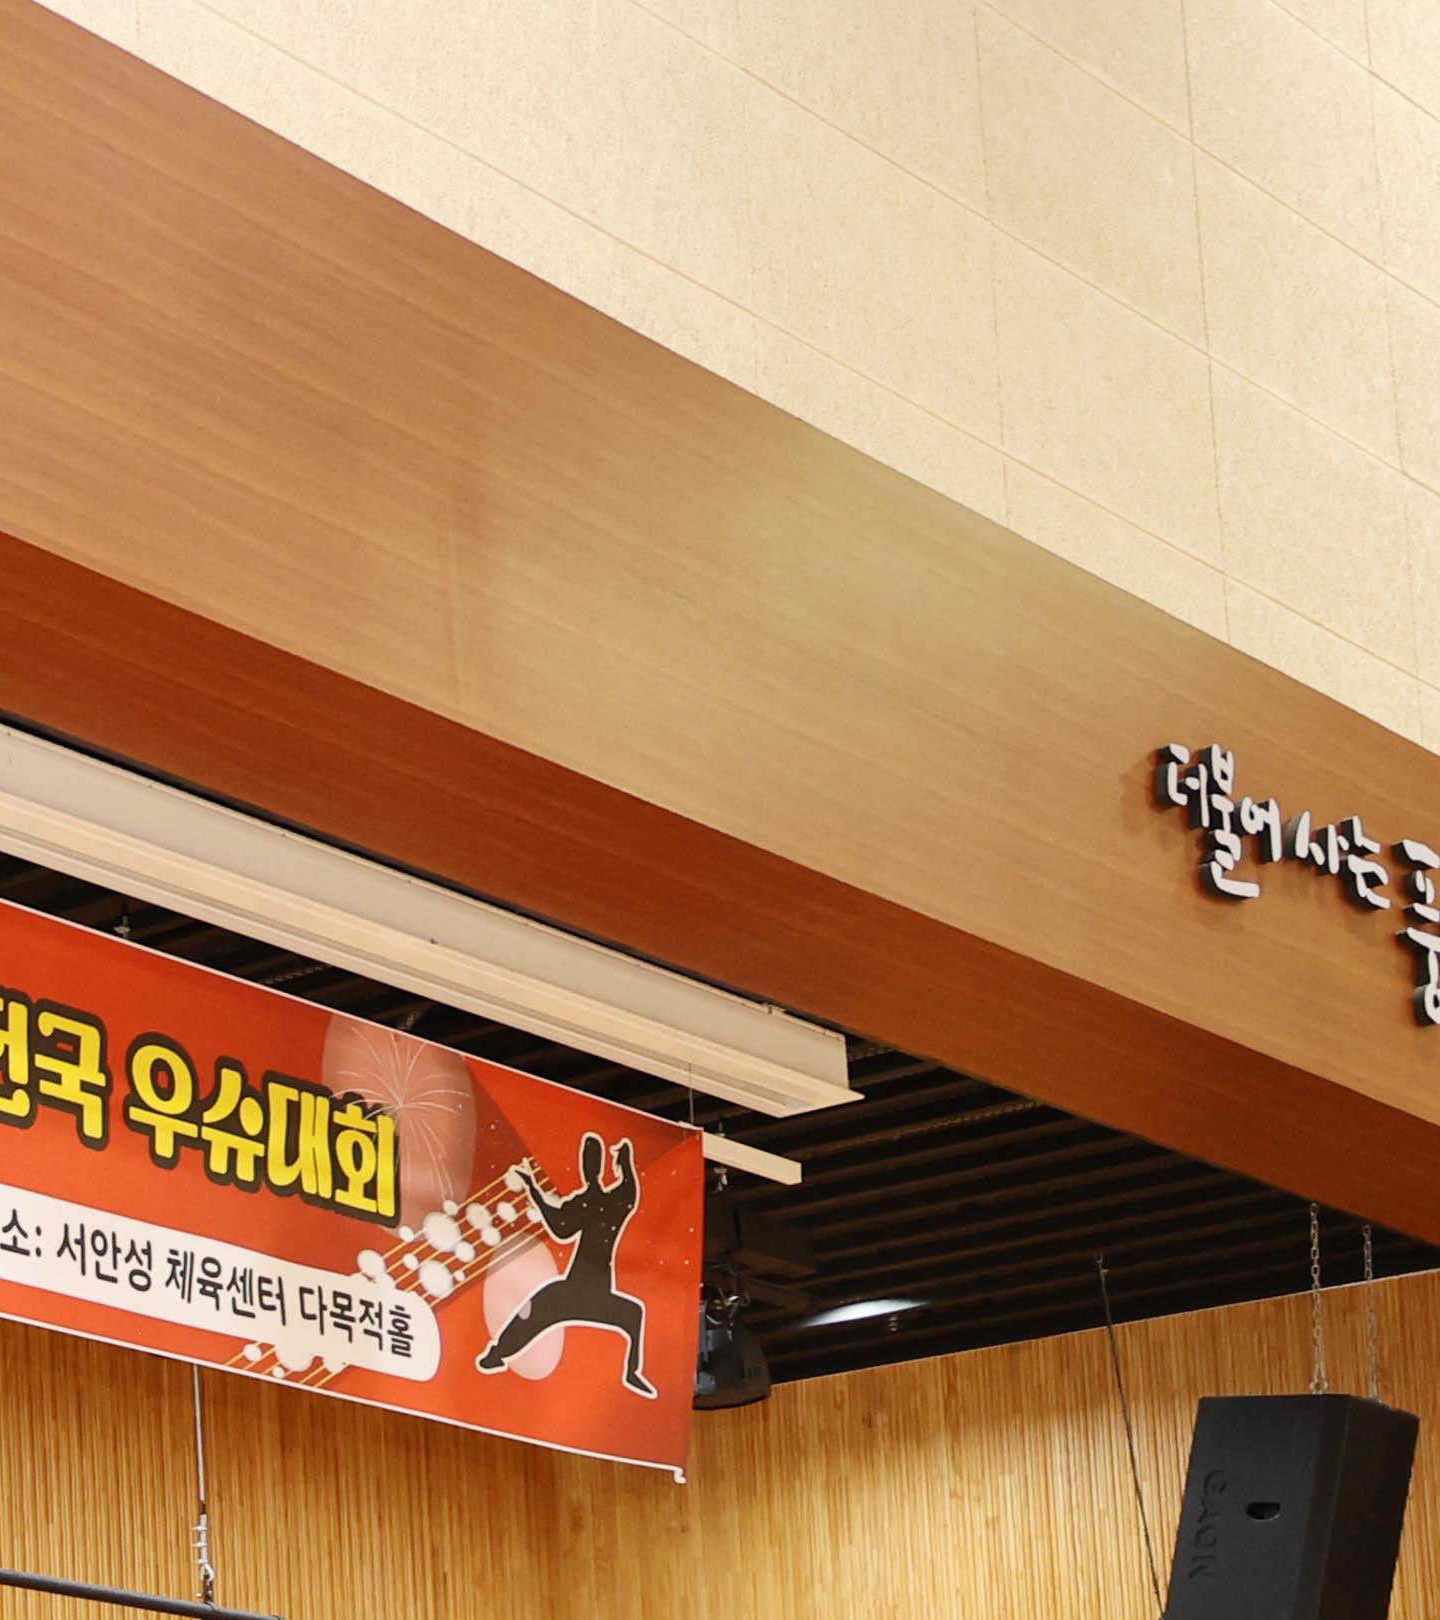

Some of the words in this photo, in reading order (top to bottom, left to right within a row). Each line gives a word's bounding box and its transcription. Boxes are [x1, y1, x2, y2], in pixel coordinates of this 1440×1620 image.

[1290, 810, 1392, 909] 사는
[126, 1040, 398, 1219] 우슈대회
[53, 1226, 154, 1294] 서안성
[164, 1245, 288, 1327] 체육센터
[297, 1280, 415, 1361] 다목적홀
